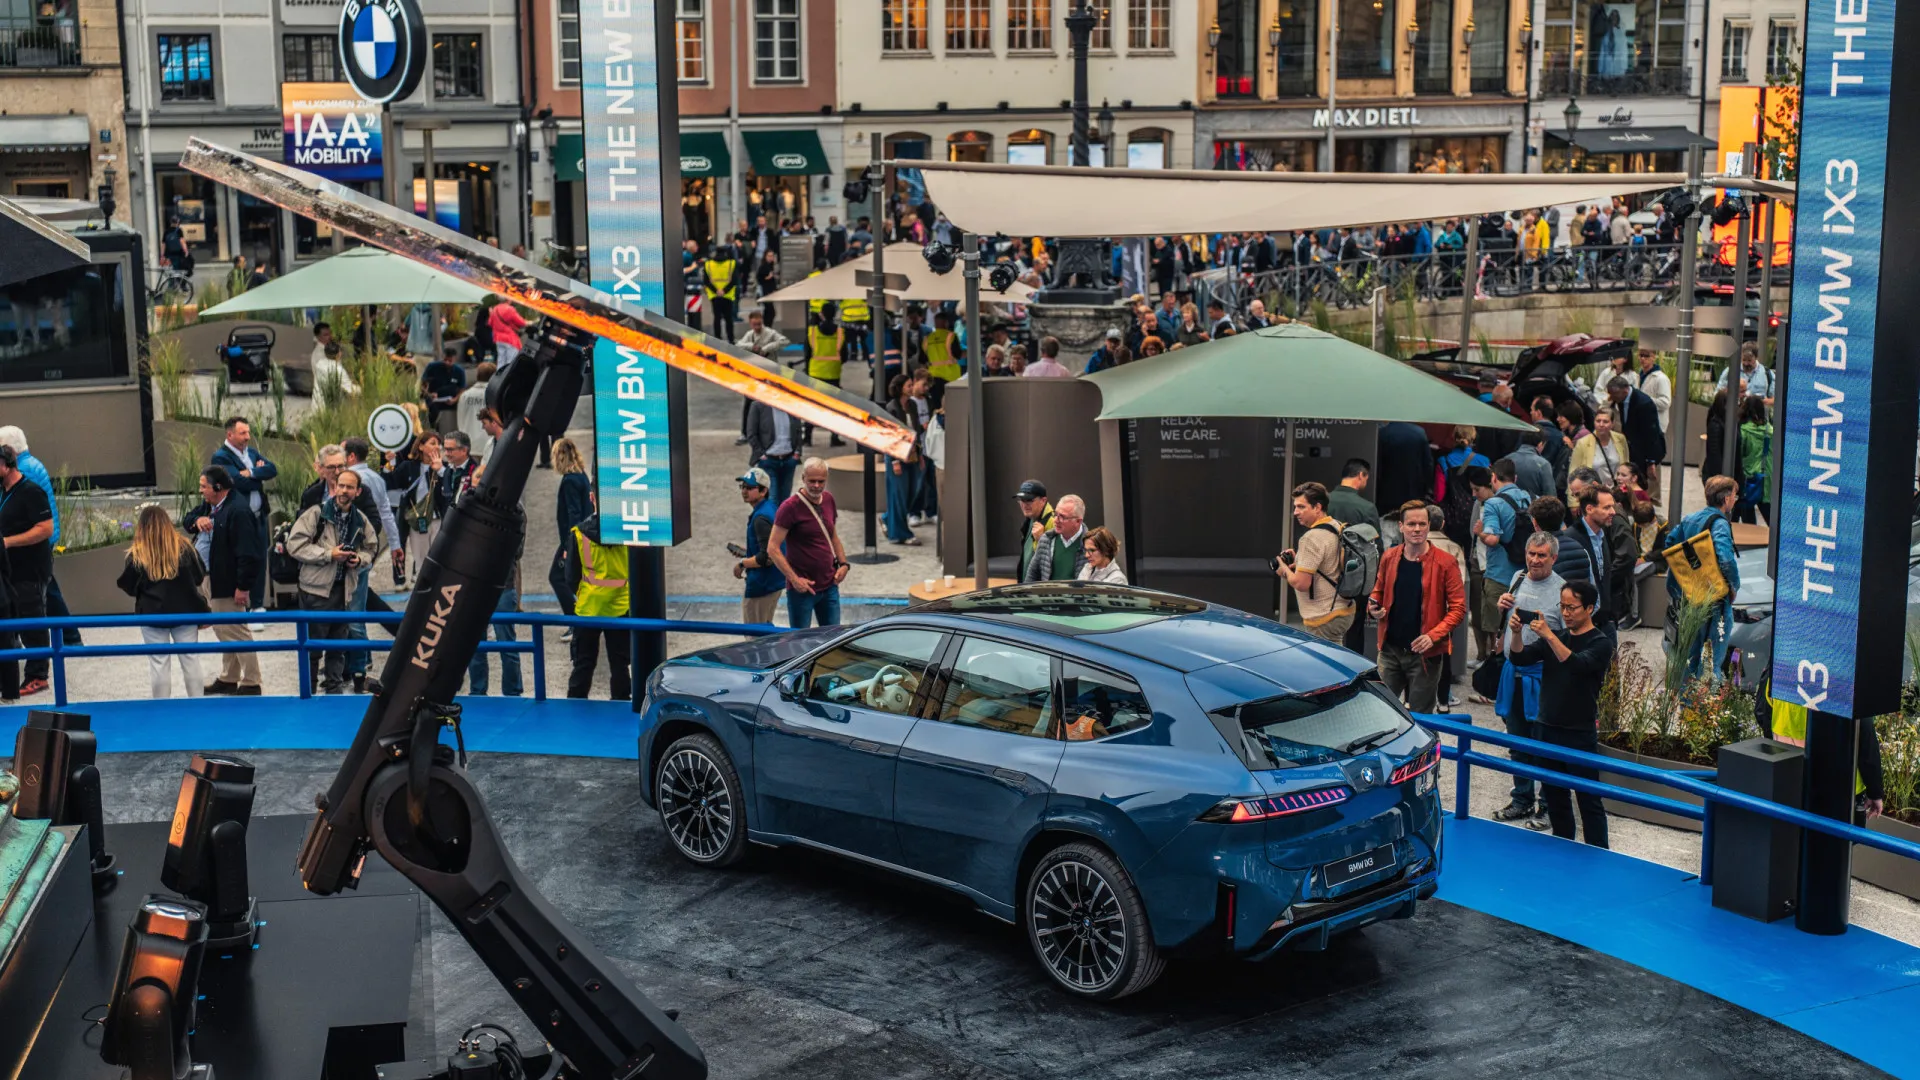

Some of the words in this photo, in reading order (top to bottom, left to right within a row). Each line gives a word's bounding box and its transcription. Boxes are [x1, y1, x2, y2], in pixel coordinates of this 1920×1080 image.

[603, 28, 635, 115] NEW
[1831, 0, 1868, 97] THE
[253, 128, 282, 141] IWC
[292, 99, 355, 109] WILLKOMMEN
[1312, 108, 1361, 127] MAX
[1364, 107, 1421, 126] DIETL
[294, 148, 372, 165] MOBILITY
[607, 125, 638, 201] THE
[1823, 158, 1859, 234] iX3
[611, 245, 641, 301] iX3
[1815, 246, 1853, 370] BMW
[615, 341, 645, 400] BM
[617, 409, 649, 491] NEW
[1160, 429, 1181, 441] WE
[1183, 429, 1221, 441] CARE.
[1295, 428, 1330, 440] BMW.
[1808, 381, 1845, 494] NEW
[1802, 505, 1838, 601] THE
[411, 584, 462, 669] KUKA
[1348, 861, 1364, 873] BMW
